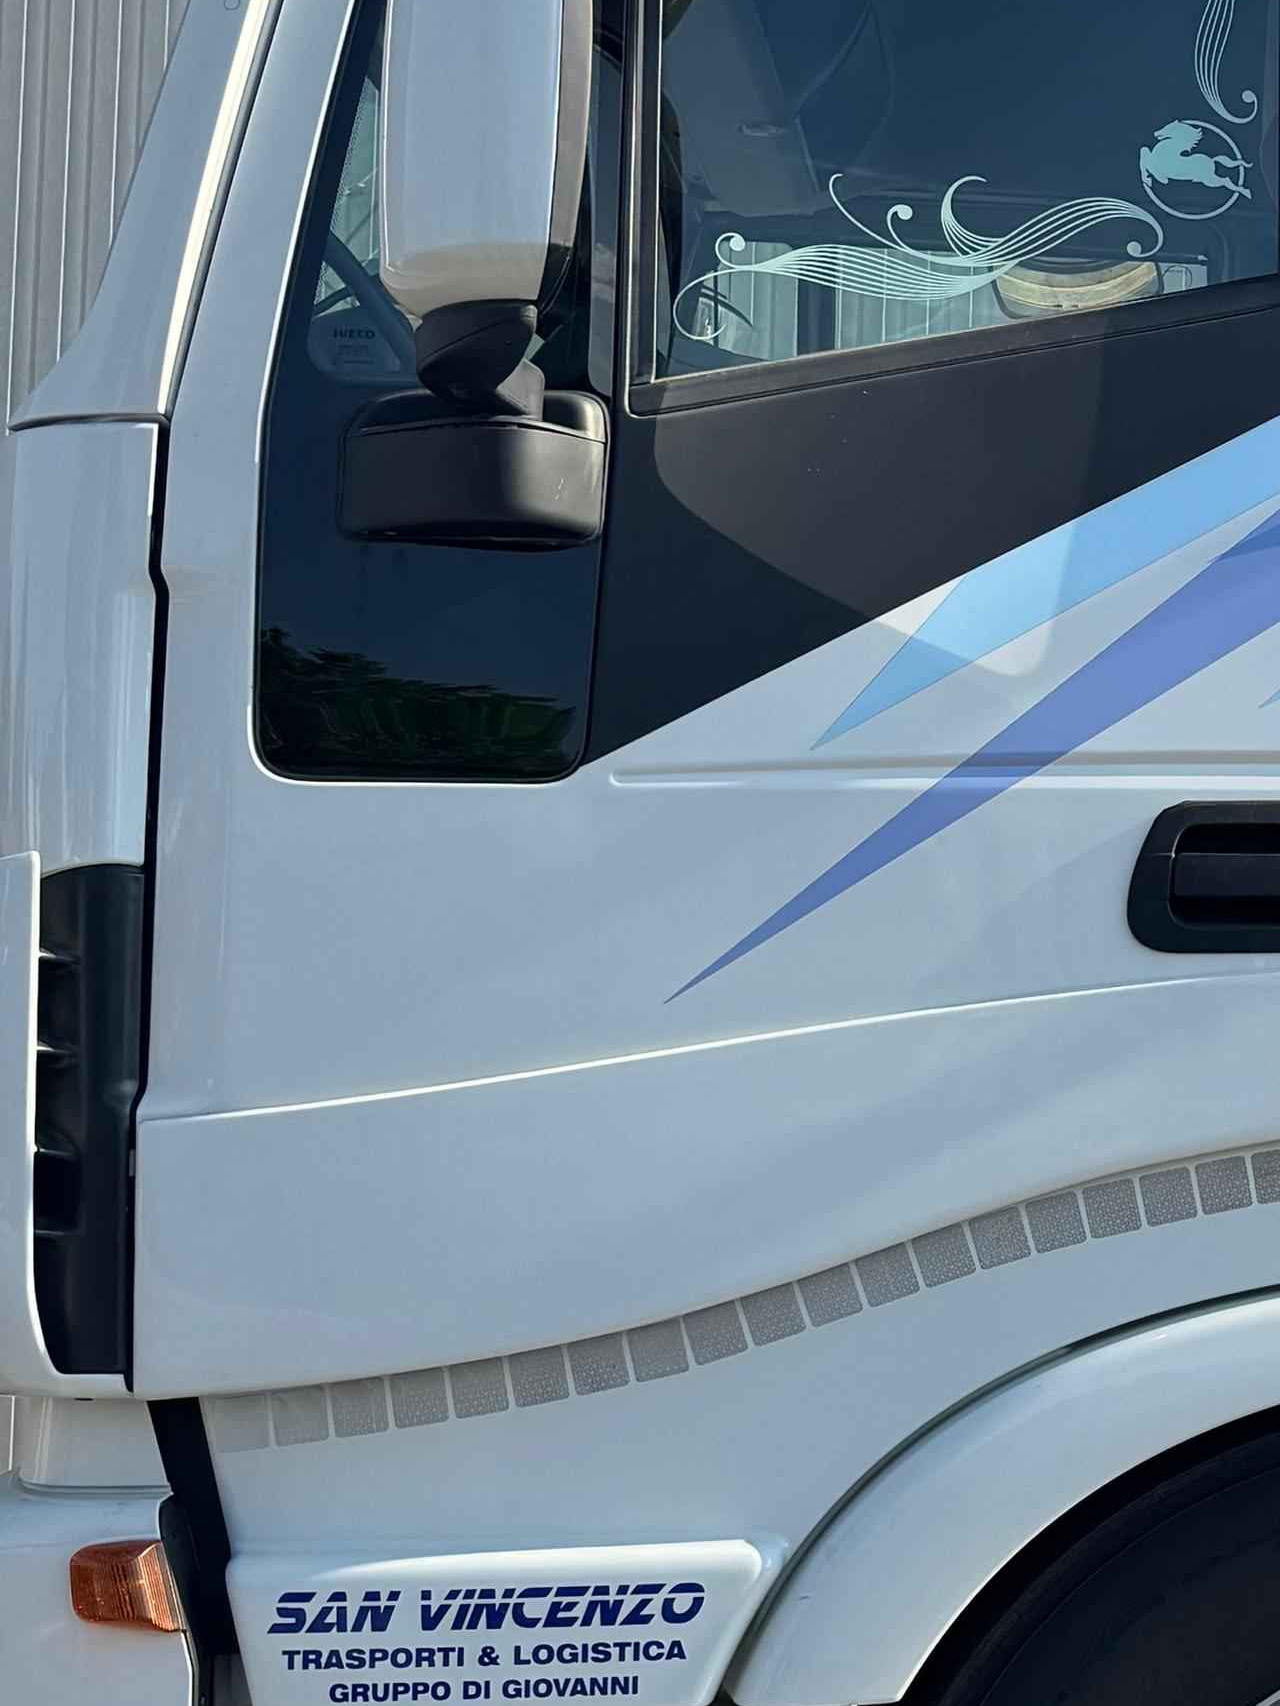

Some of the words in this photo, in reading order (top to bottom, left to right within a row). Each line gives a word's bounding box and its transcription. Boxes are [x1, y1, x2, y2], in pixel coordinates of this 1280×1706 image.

[333, 329, 376, 339] IVECO
[266, 1588, 402, 1635] SAN
[418, 1581, 706, 1632] VINCENZO
[282, 1645, 466, 1671] TRASPORTI
[476, 1644, 501, 1666] &
[513, 1639, 688, 1666] LOGISTICA
[328, 1680, 452, 1704] GRUPPO
[461, 1679, 492, 1701] DI
[501, 1675, 640, 1700] GIOVANNI
